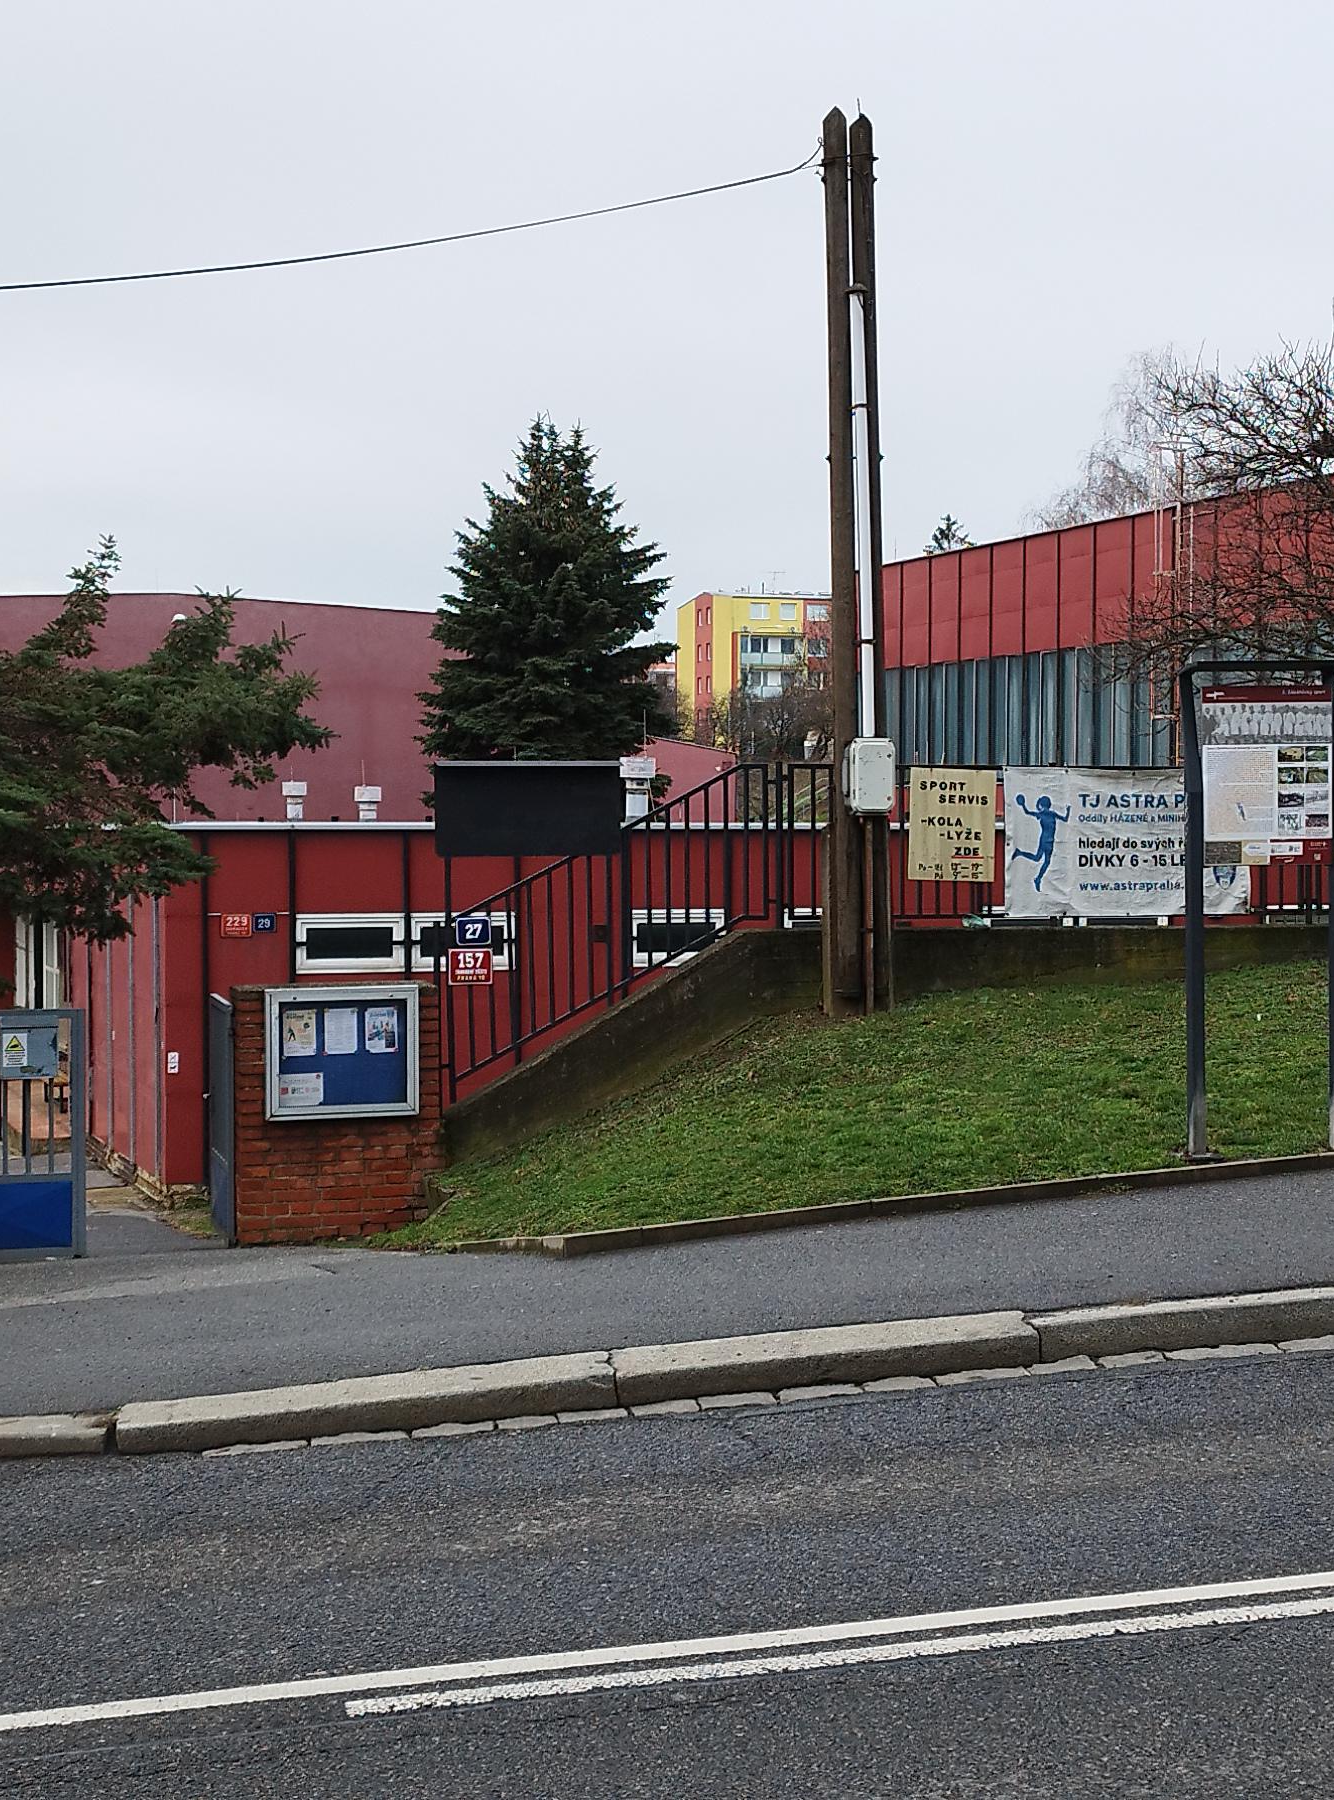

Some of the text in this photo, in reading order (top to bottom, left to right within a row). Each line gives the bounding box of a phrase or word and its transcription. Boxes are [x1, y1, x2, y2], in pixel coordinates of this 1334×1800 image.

[919, 780, 966, 791] SPORT
[938, 794, 989, 806] SERVIS
[1078, 793, 1101, 808] TJ
[1106, 793, 1168, 809] ASTRA
[1078, 837, 1120, 851] hledají
[1122, 837, 1138, 849] do
[1140, 837, 1175, 851] svých
[954, 846, 980, 856] ZDE
[1078, 851, 1126, 867] DÍVKY
[1130, 854, 1139, 867] 6
[1151, 854, 1167, 867] 15
[226, 916, 248, 927] 229
[258, 918, 271, 928] 29
[465, 923, 482, 939] 27
[458, 952, 484, 968] 157
